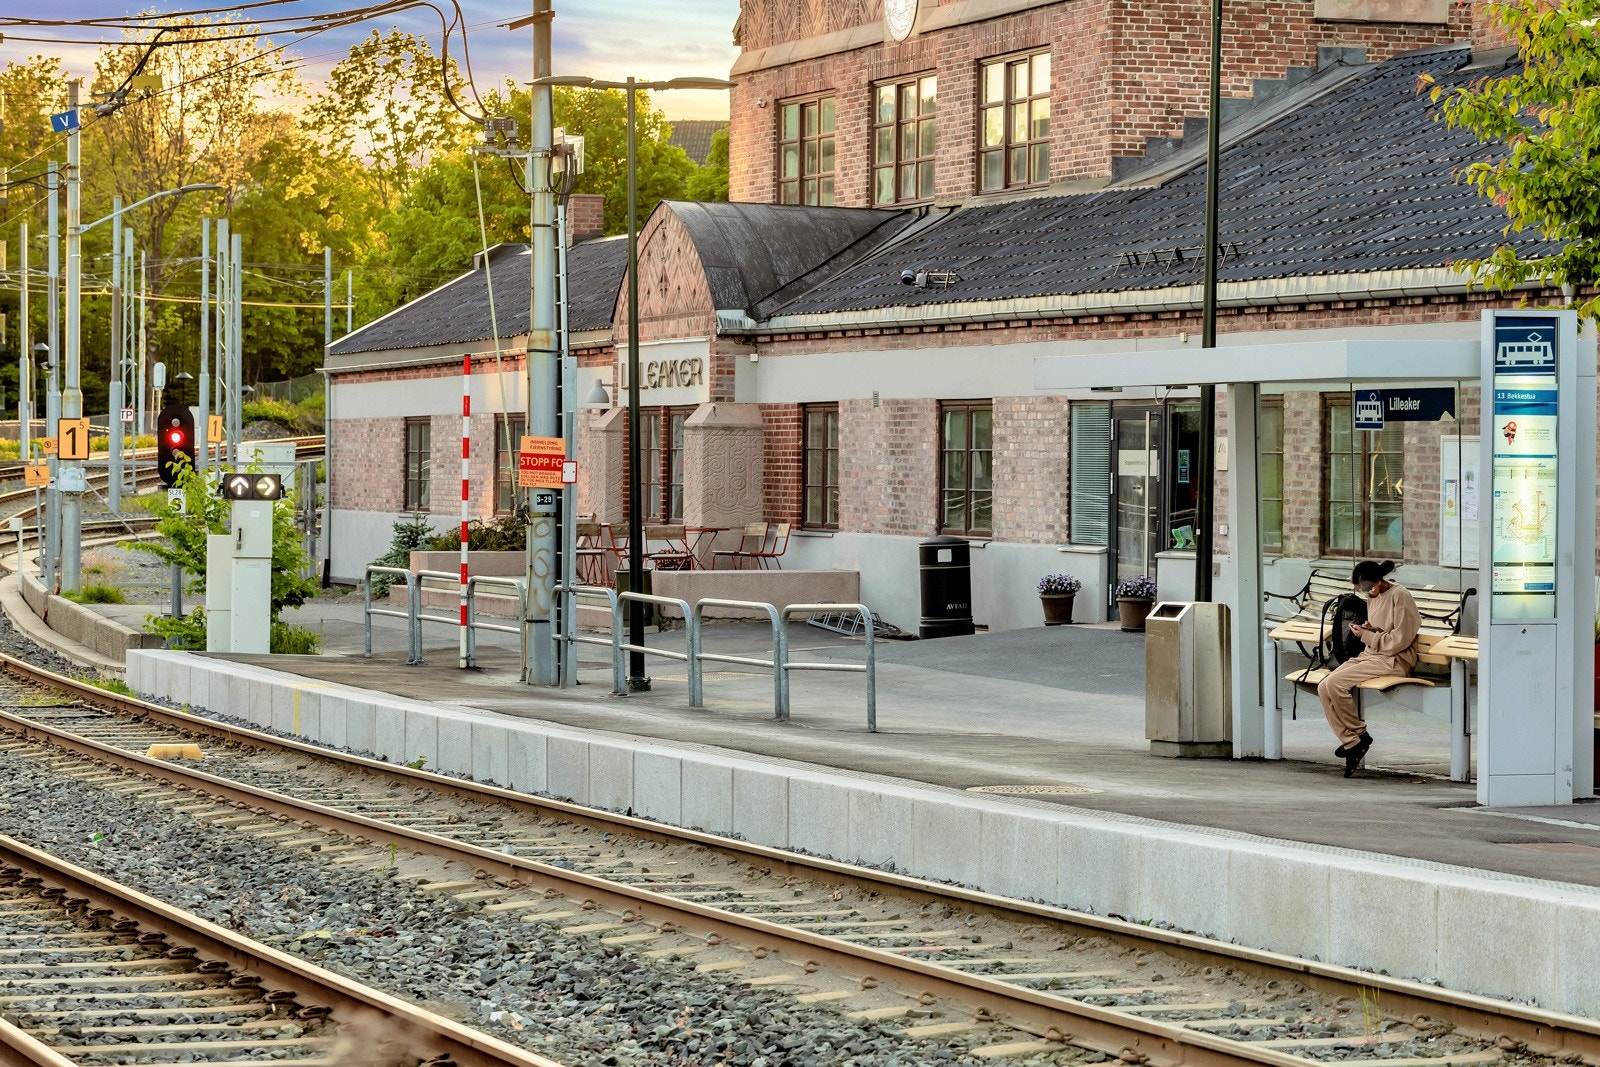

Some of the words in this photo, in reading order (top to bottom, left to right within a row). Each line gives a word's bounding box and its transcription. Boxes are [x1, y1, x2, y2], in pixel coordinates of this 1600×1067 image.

[60, 115, 69, 127] V
[621, 357, 704, 390] LLEAKER
[1497, 392, 1506, 400] 13
[1507, 392, 1536, 400] Bekkestua
[1389, 397, 1421, 411] Lilleaker
[120, 410, 133, 419] TP
[65, 427, 76, 456] 1
[520, 456, 550, 467] STOPP
[551, 459, 565, 468] FO
